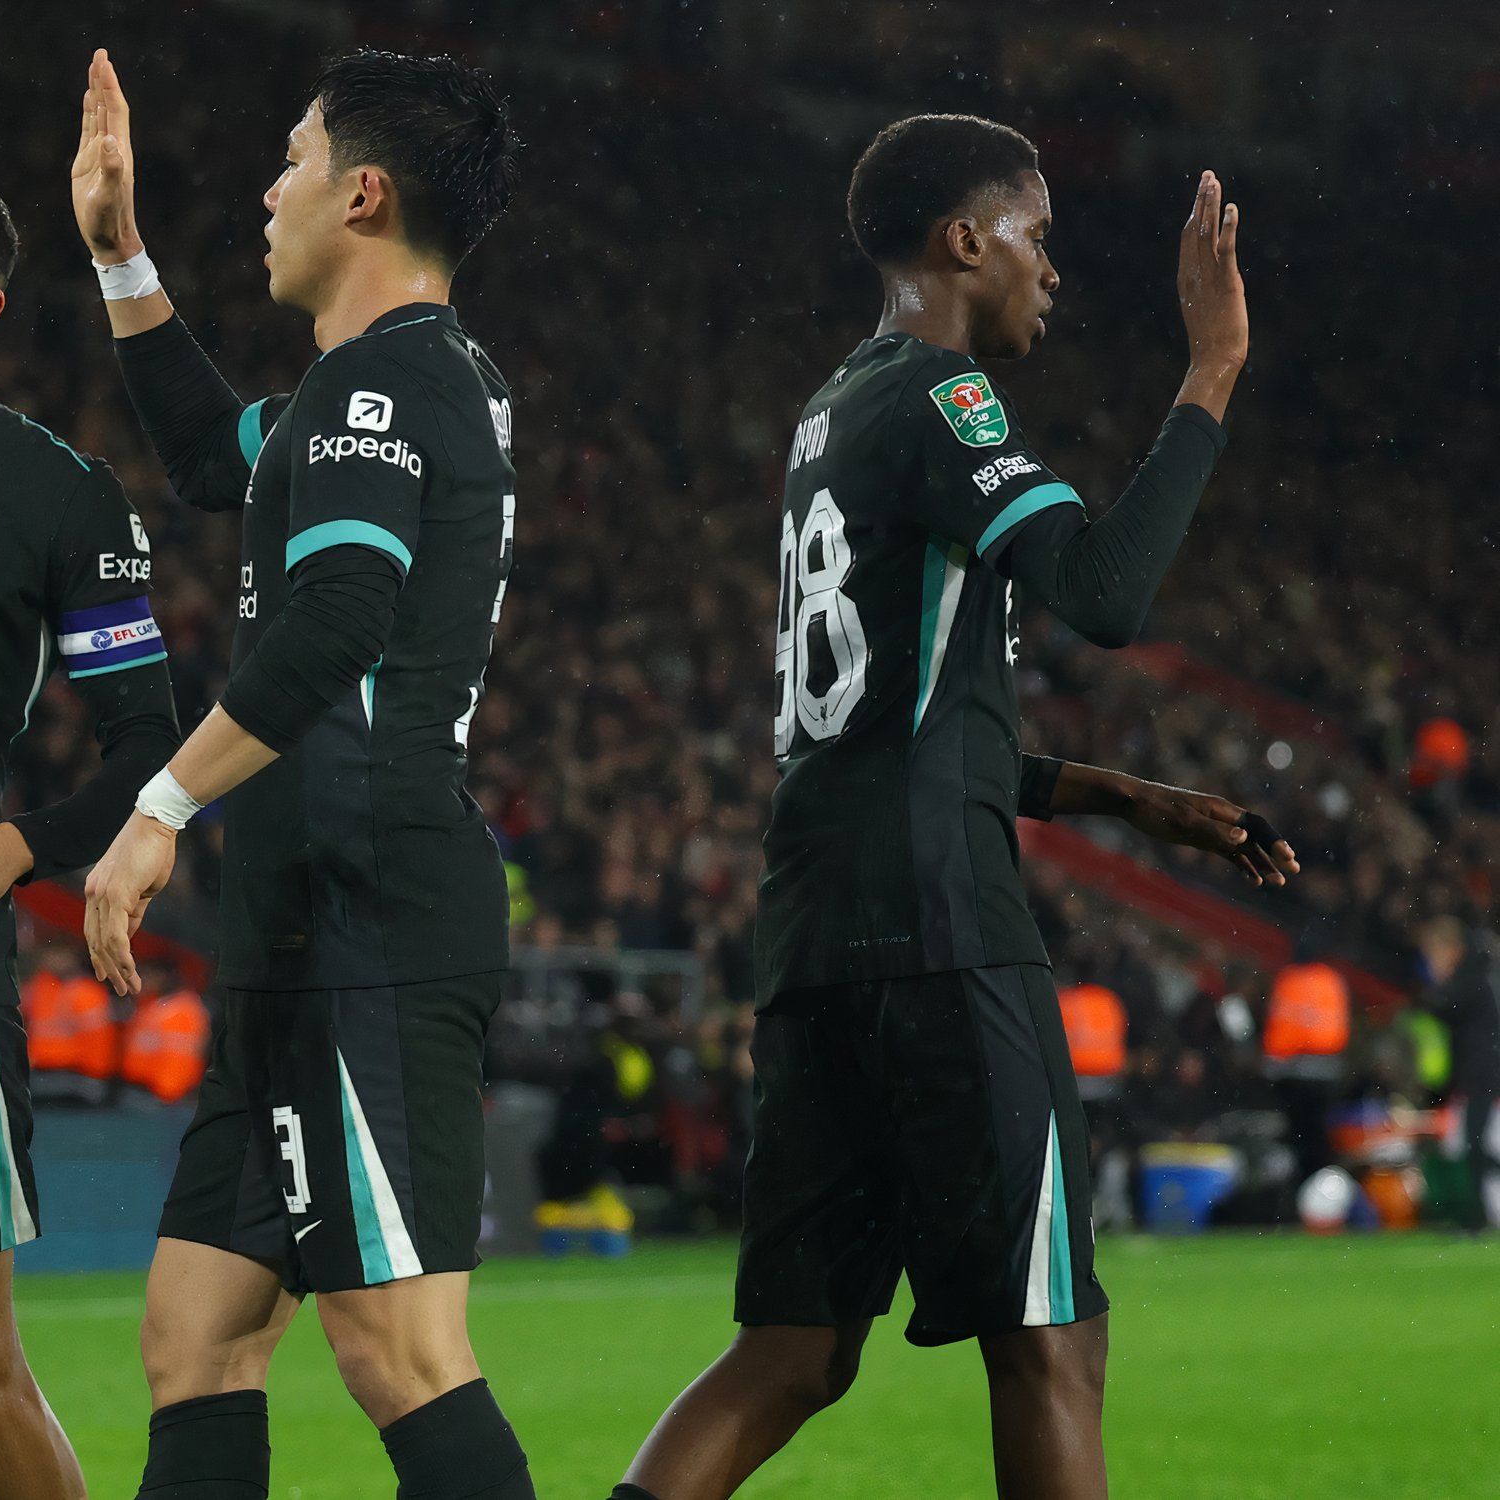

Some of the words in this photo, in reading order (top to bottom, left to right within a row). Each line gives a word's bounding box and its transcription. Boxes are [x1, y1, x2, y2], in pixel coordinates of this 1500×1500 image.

[969, 412, 989, 426] Cup
[309, 434, 422, 479] Expedia
[972, 465, 996, 484] No
[980, 474, 1001, 496] for
[774, 488, 867, 757] 98
[113, 628, 137, 642] EFL
[272, 1105, 312, 1214] 3
